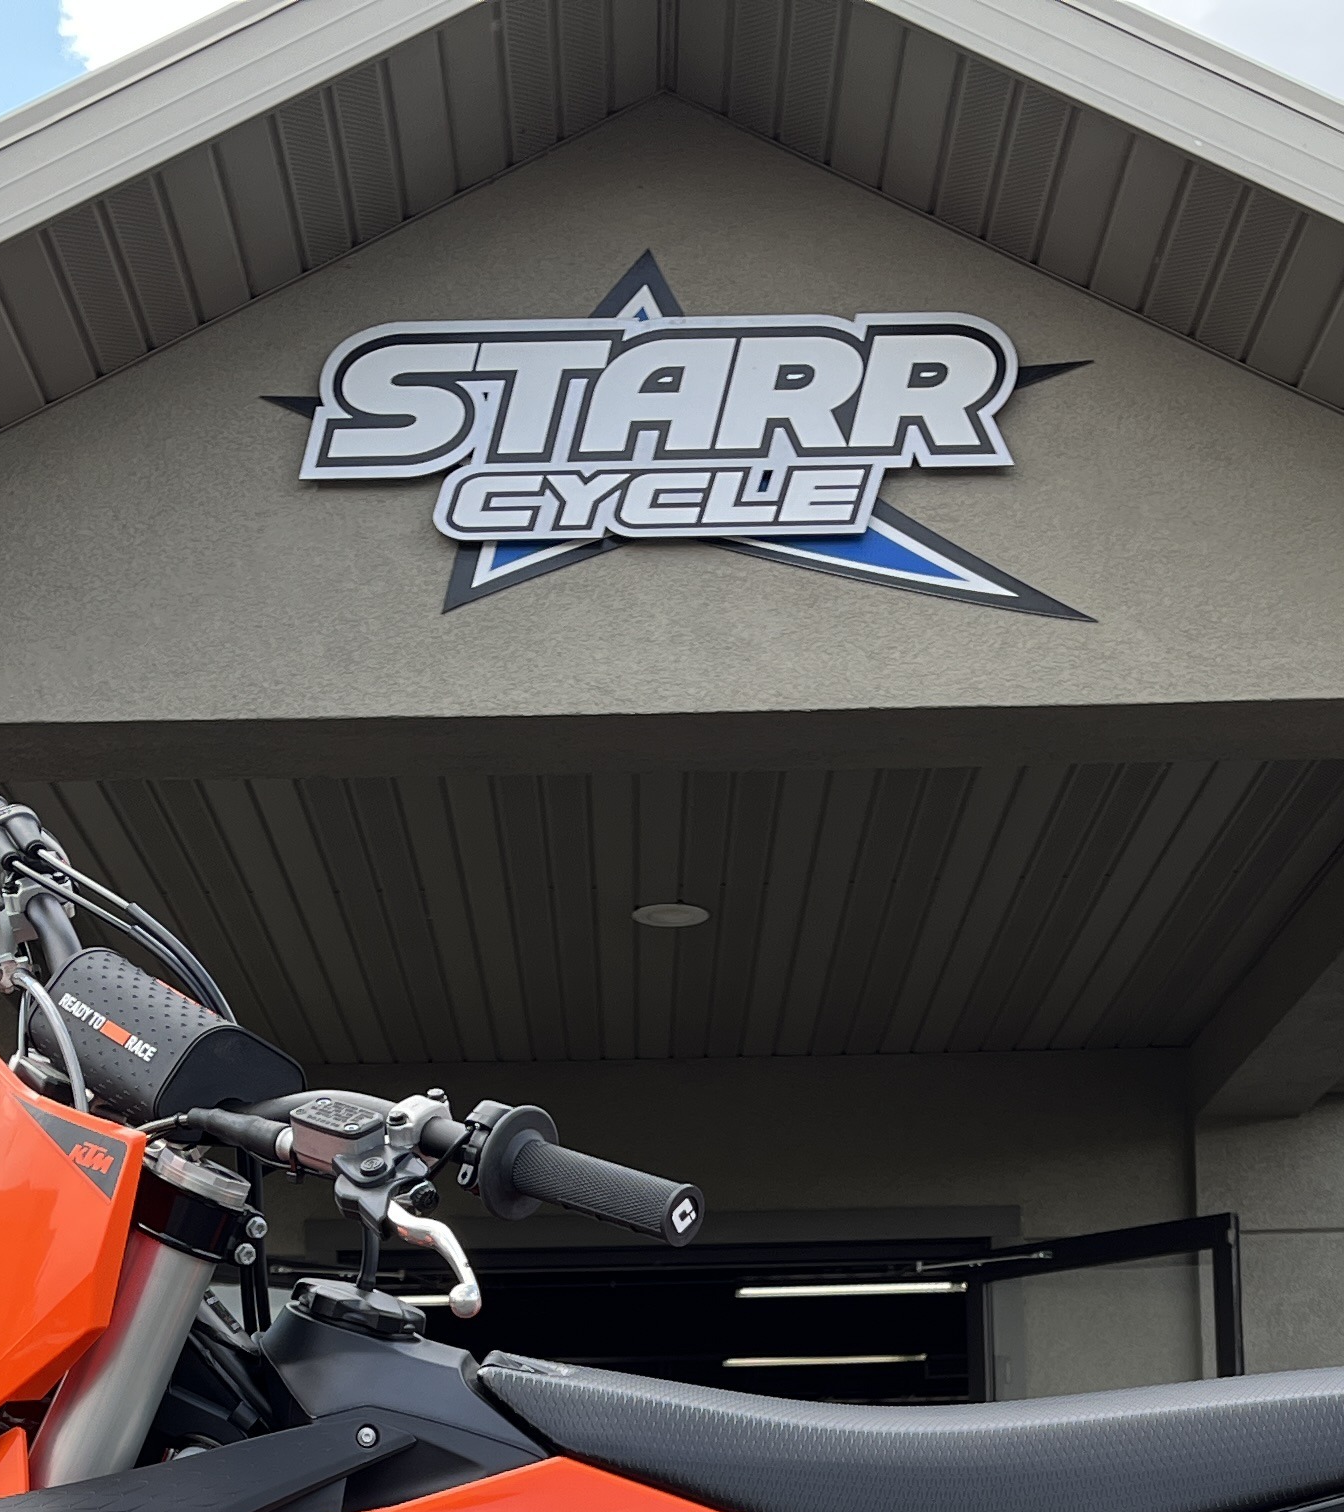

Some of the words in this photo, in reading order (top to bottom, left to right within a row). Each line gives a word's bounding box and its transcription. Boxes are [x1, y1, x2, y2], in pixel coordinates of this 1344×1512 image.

[318, 328, 1006, 462] STARR
[447, 469, 869, 529] CYCLE
[58, 992, 94, 1022] READY
[88, 1011, 107, 1031] TO
[124, 1034, 158, 1062] RACE
[68, 1141, 115, 1175] KTM
